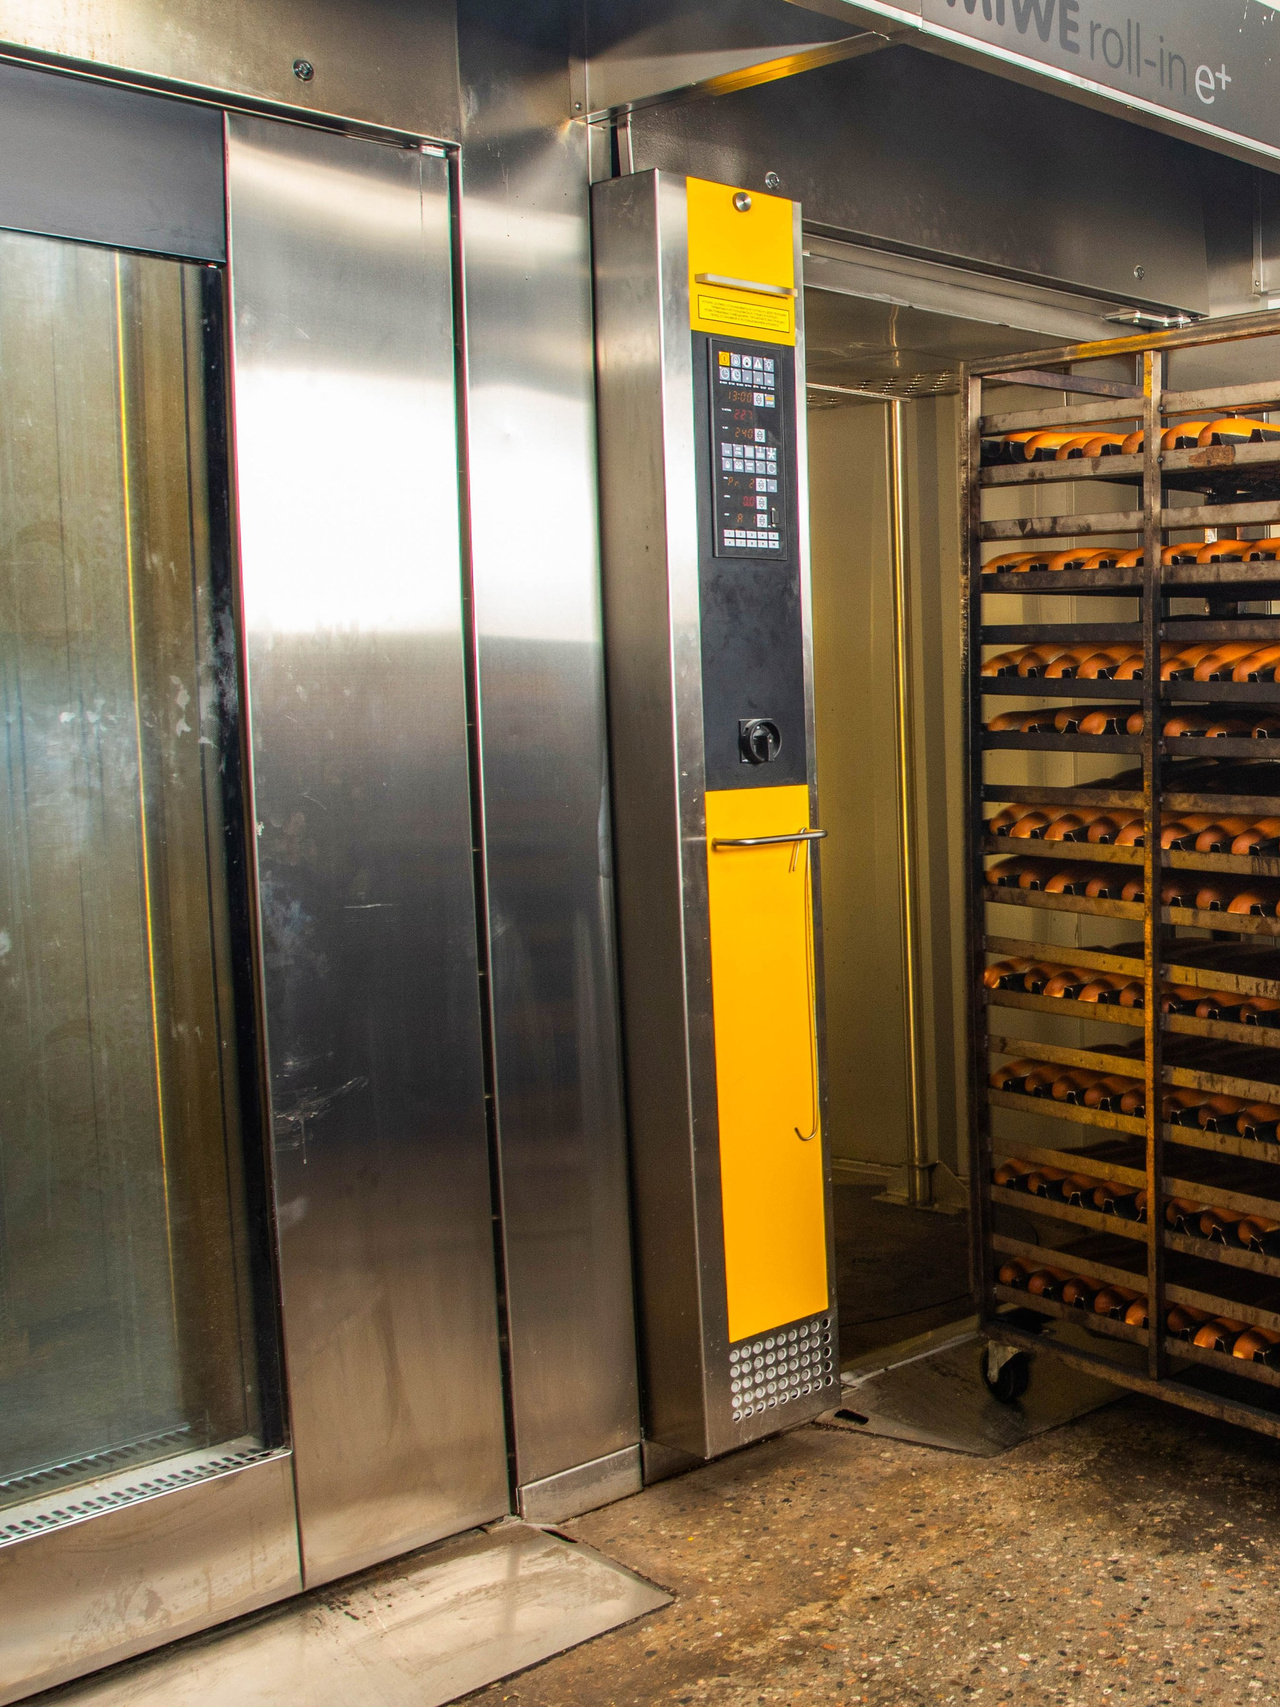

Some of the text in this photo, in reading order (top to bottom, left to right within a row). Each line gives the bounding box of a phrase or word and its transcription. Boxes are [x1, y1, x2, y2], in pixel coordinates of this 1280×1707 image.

[946, 0, 1080, 54] WE
[1089, 18, 1187, 96] roll-in
[728, 390, 752, 403] 13:00
[733, 408, 753, 420] 227
[734, 426, 754, 439] 240
